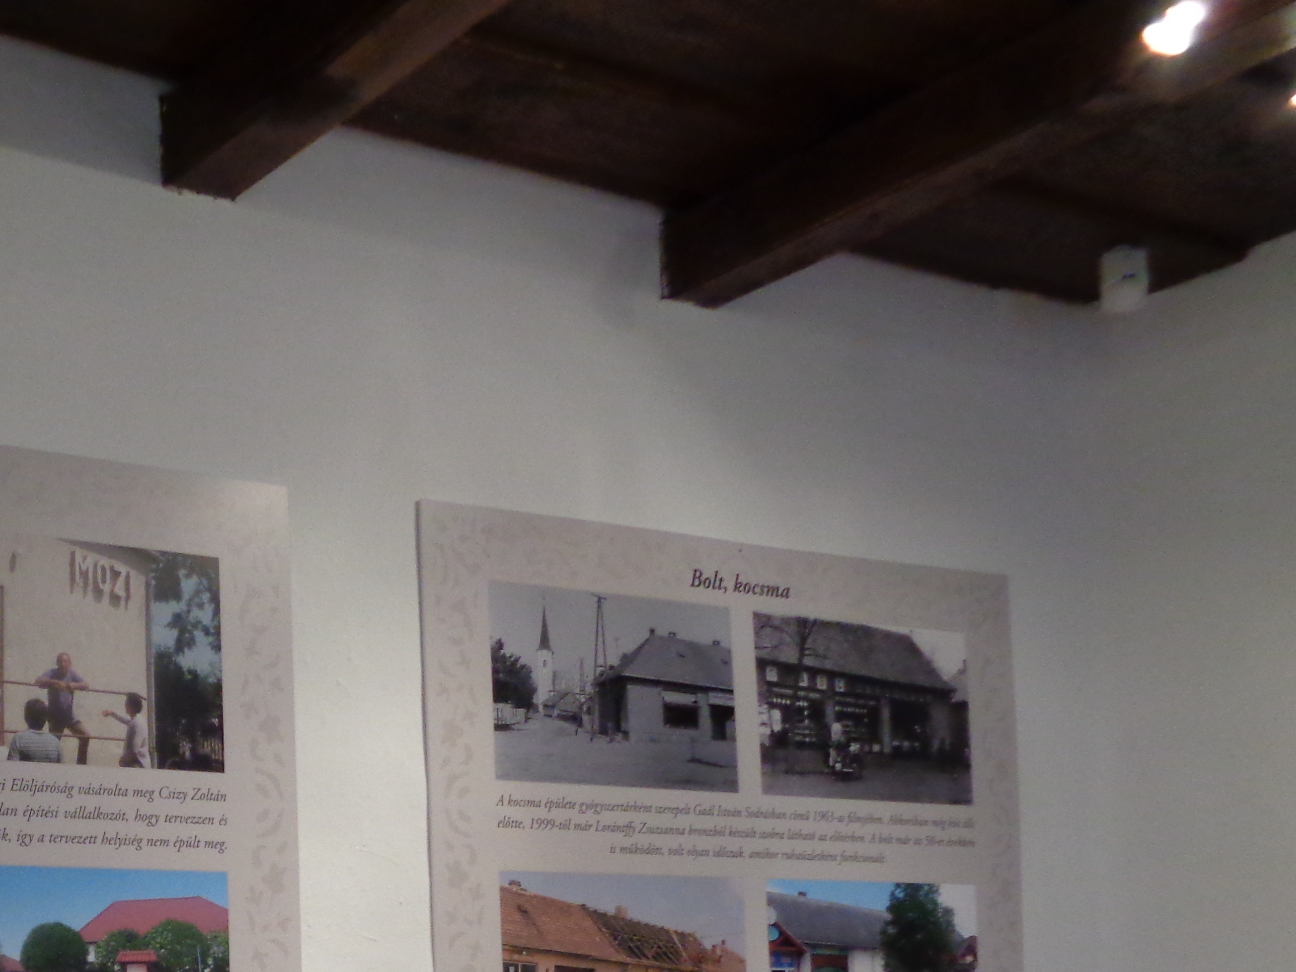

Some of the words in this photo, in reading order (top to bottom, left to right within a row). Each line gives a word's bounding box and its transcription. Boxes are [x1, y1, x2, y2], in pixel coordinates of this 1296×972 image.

[69, 549, 135, 607] MOZI
[689, 568, 727, 594] Bolt,
[733, 573, 791, 599] kocsma
[10, 778, 74, 799] Elöljáróság
[78, 783, 129, 797] vásárolta
[132, 789, 155, 802] meg
[190, 787, 227, 802] Zoltán
[496, 794, 504, 807] A
[507, 794, 542, 808] kocsma
[544, 797, 576, 812] épülete
[22, 804, 59, 822] építési
[64, 806, 129, 823] vállalkozót,
[134, 808, 161, 827] hogy
[164, 812, 215, 825] tervezzen
[218, 814, 228, 826] és
[497, 816, 526, 830] előtte,
[529, 817, 572, 831] 1999-től
[573, 821, 593, 832] már
[16, 832, 35, 847] így
[37, 832, 45, 843] a
[48, 833, 98, 845] tervezett
[101, 832, 143, 851] helyiség
[146, 836, 170, 848] nem
[173, 835, 201, 852] épült
[204, 840, 228, 854] meg.
